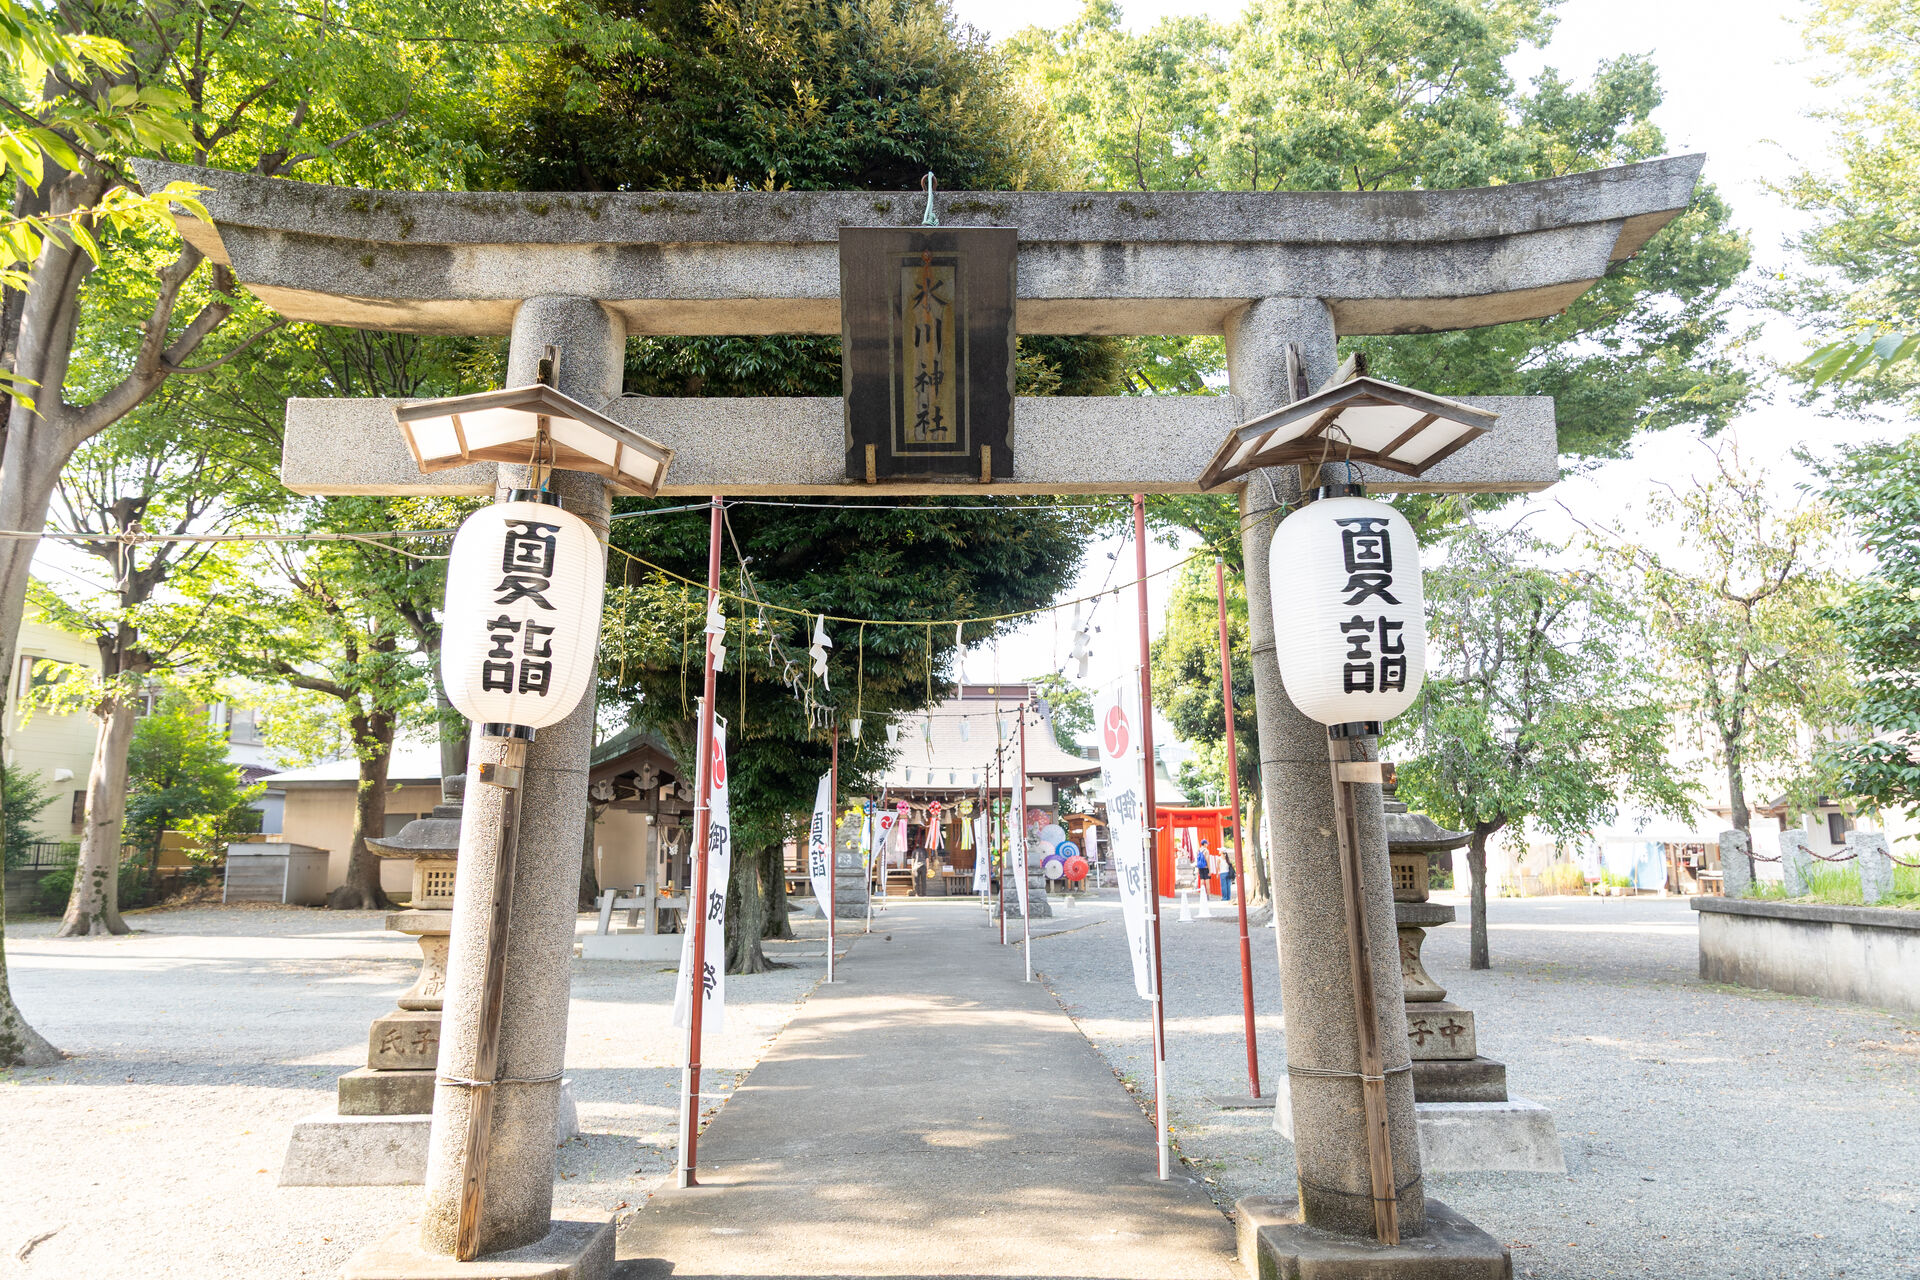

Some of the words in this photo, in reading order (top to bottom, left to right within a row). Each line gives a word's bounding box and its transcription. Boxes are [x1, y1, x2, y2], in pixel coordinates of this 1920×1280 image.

[912, 277, 949, 435] 氷川神社
[482, 518, 562, 697] 夏詣
[1332, 517, 1407, 694] 夏詣
[811, 811, 827, 878] 夏詣
